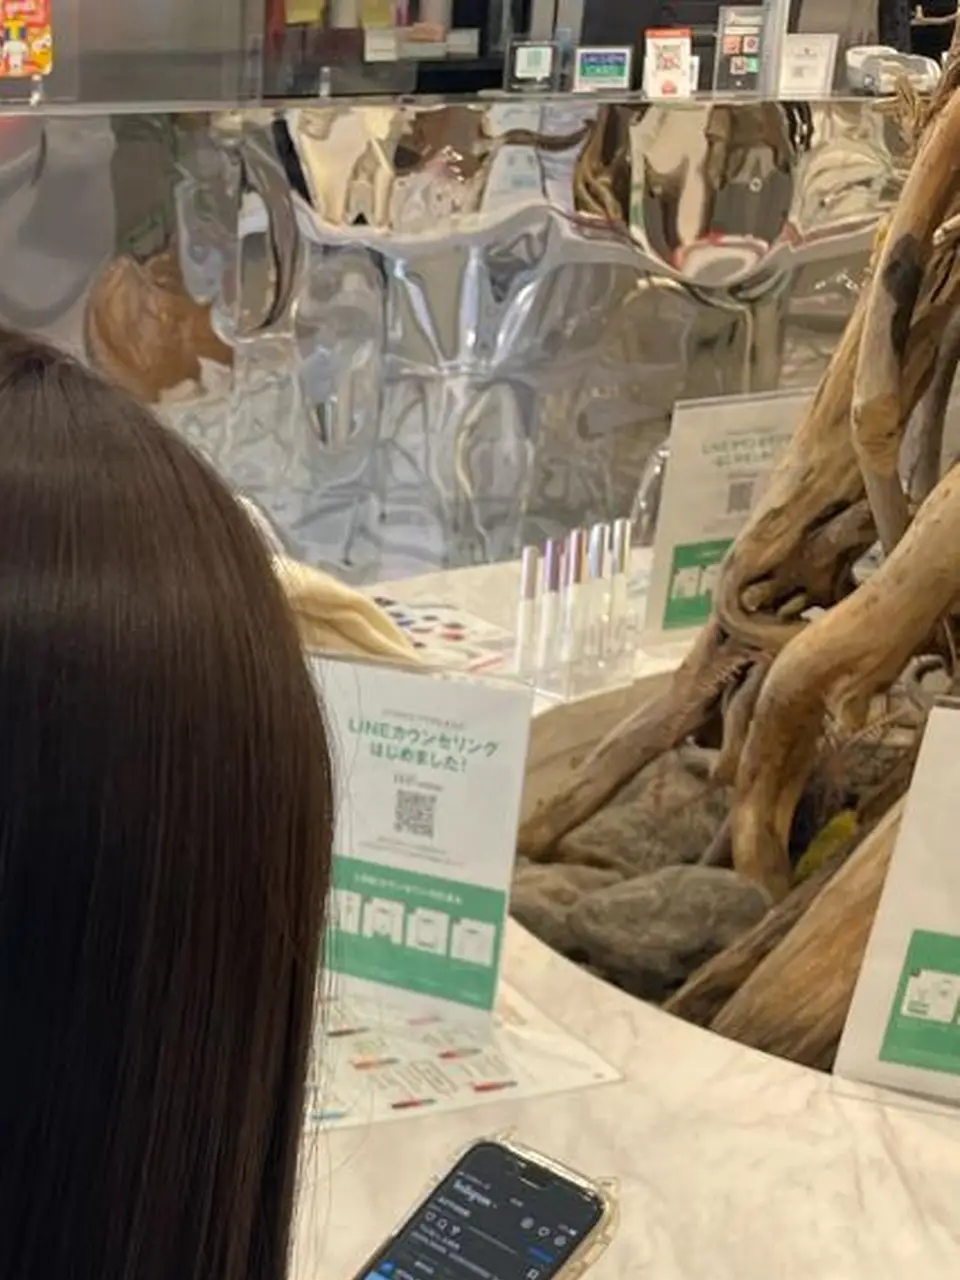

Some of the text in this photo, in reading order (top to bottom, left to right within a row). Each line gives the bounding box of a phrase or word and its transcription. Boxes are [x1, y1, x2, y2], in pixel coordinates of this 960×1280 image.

[348, 717, 499, 757] LINEカウンセリング
